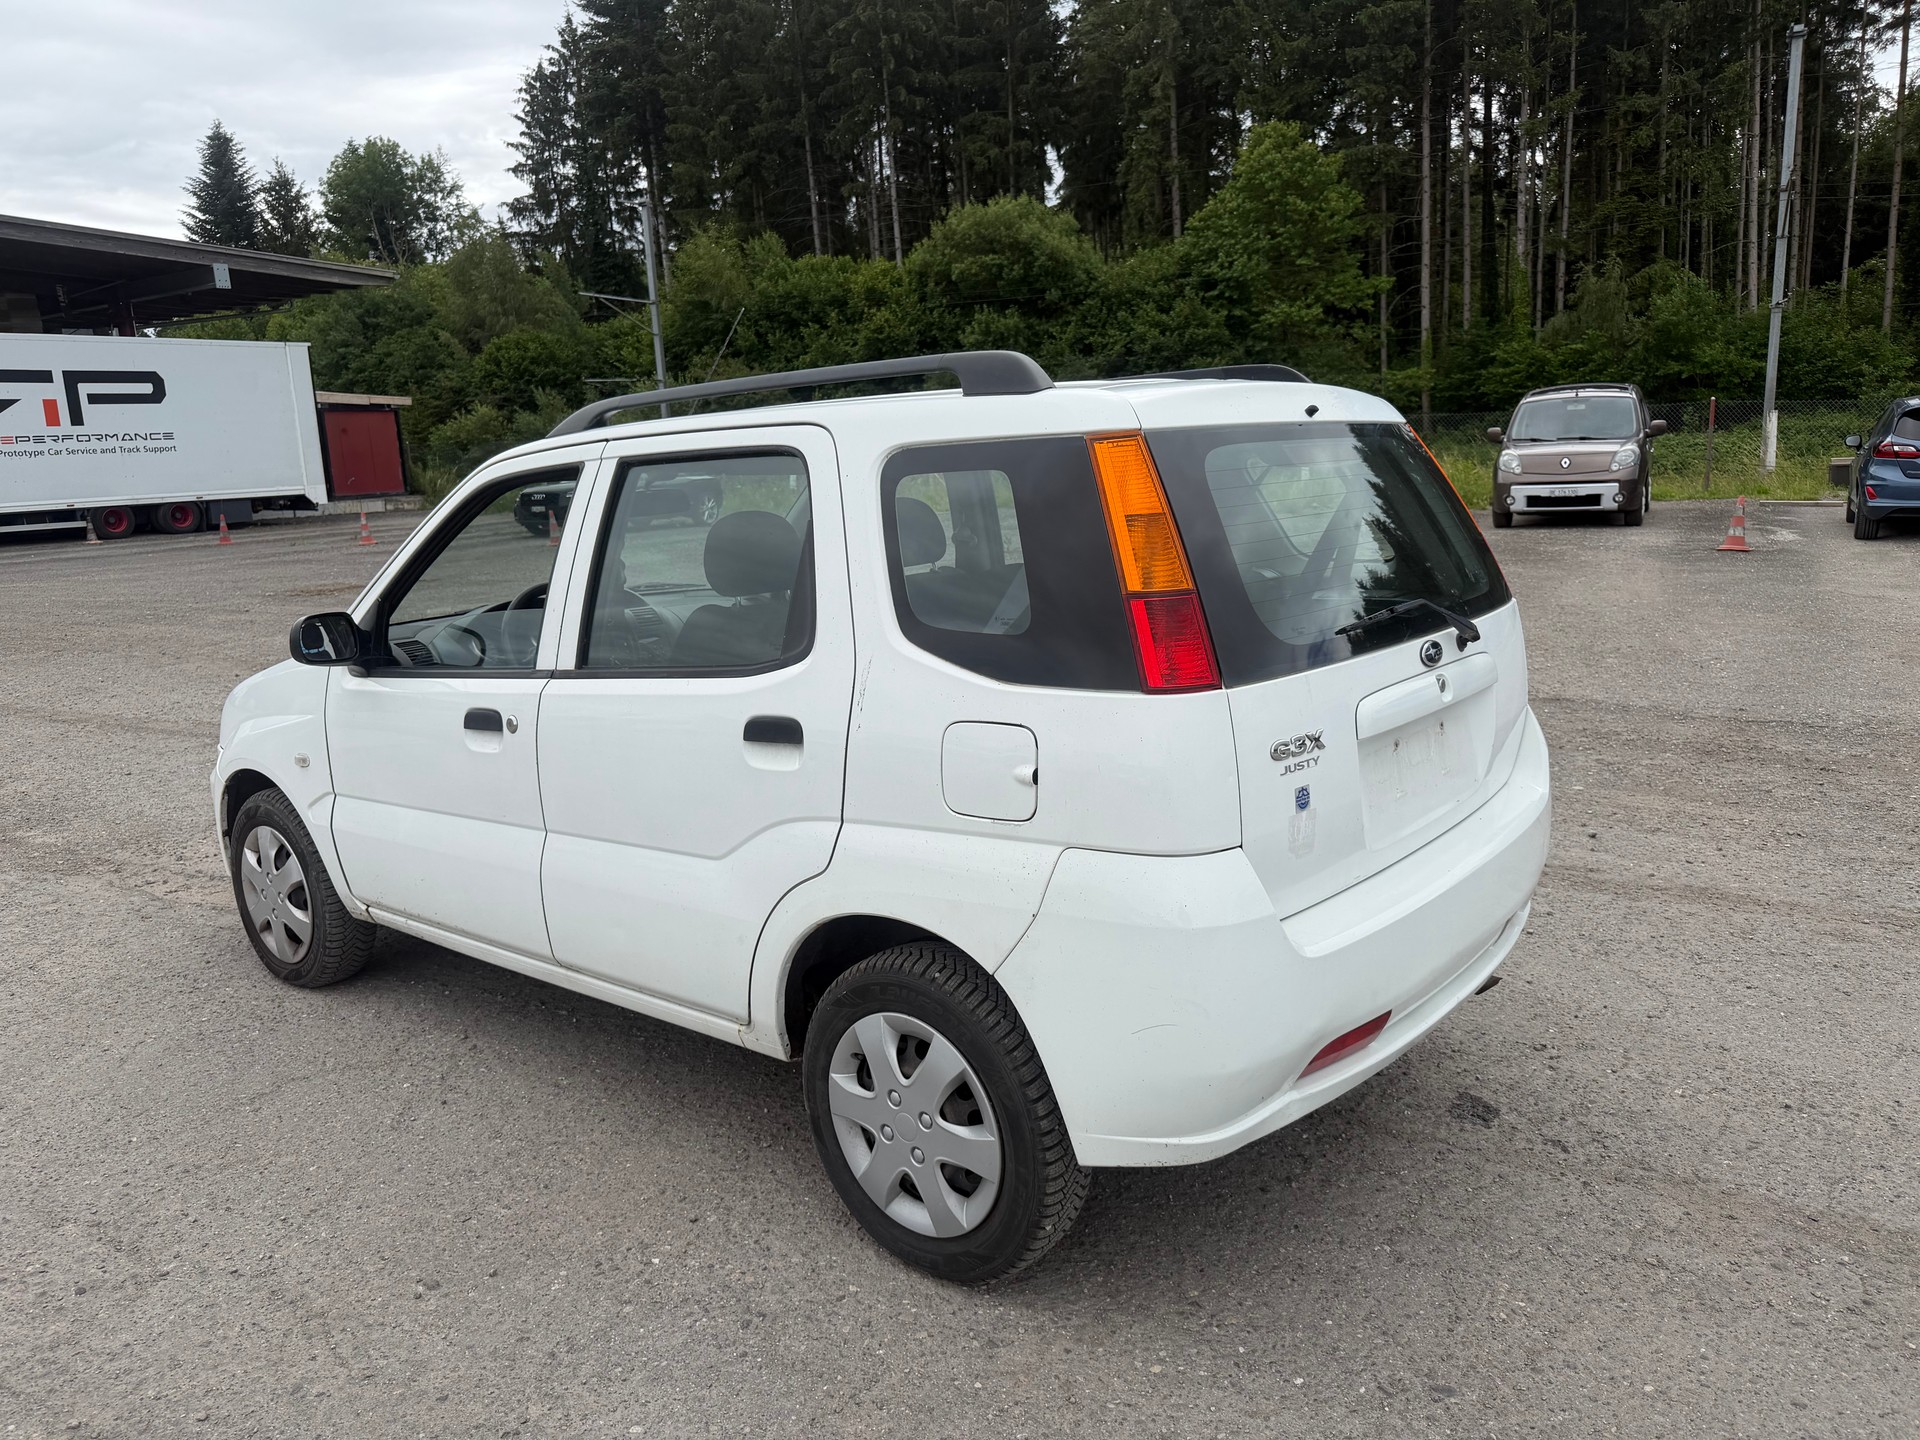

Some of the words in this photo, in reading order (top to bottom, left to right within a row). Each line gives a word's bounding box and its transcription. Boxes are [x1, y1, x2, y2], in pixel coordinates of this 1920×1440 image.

[47, 447, 63, 456] Car
[65, 446, 98, 456] Service
[99, 446, 117, 454] and
[118, 445, 141, 454] Track
[143, 444, 177, 454] Support
[1269, 728, 1326, 762] G3X
[1280, 756, 1320, 776] JUSTY
